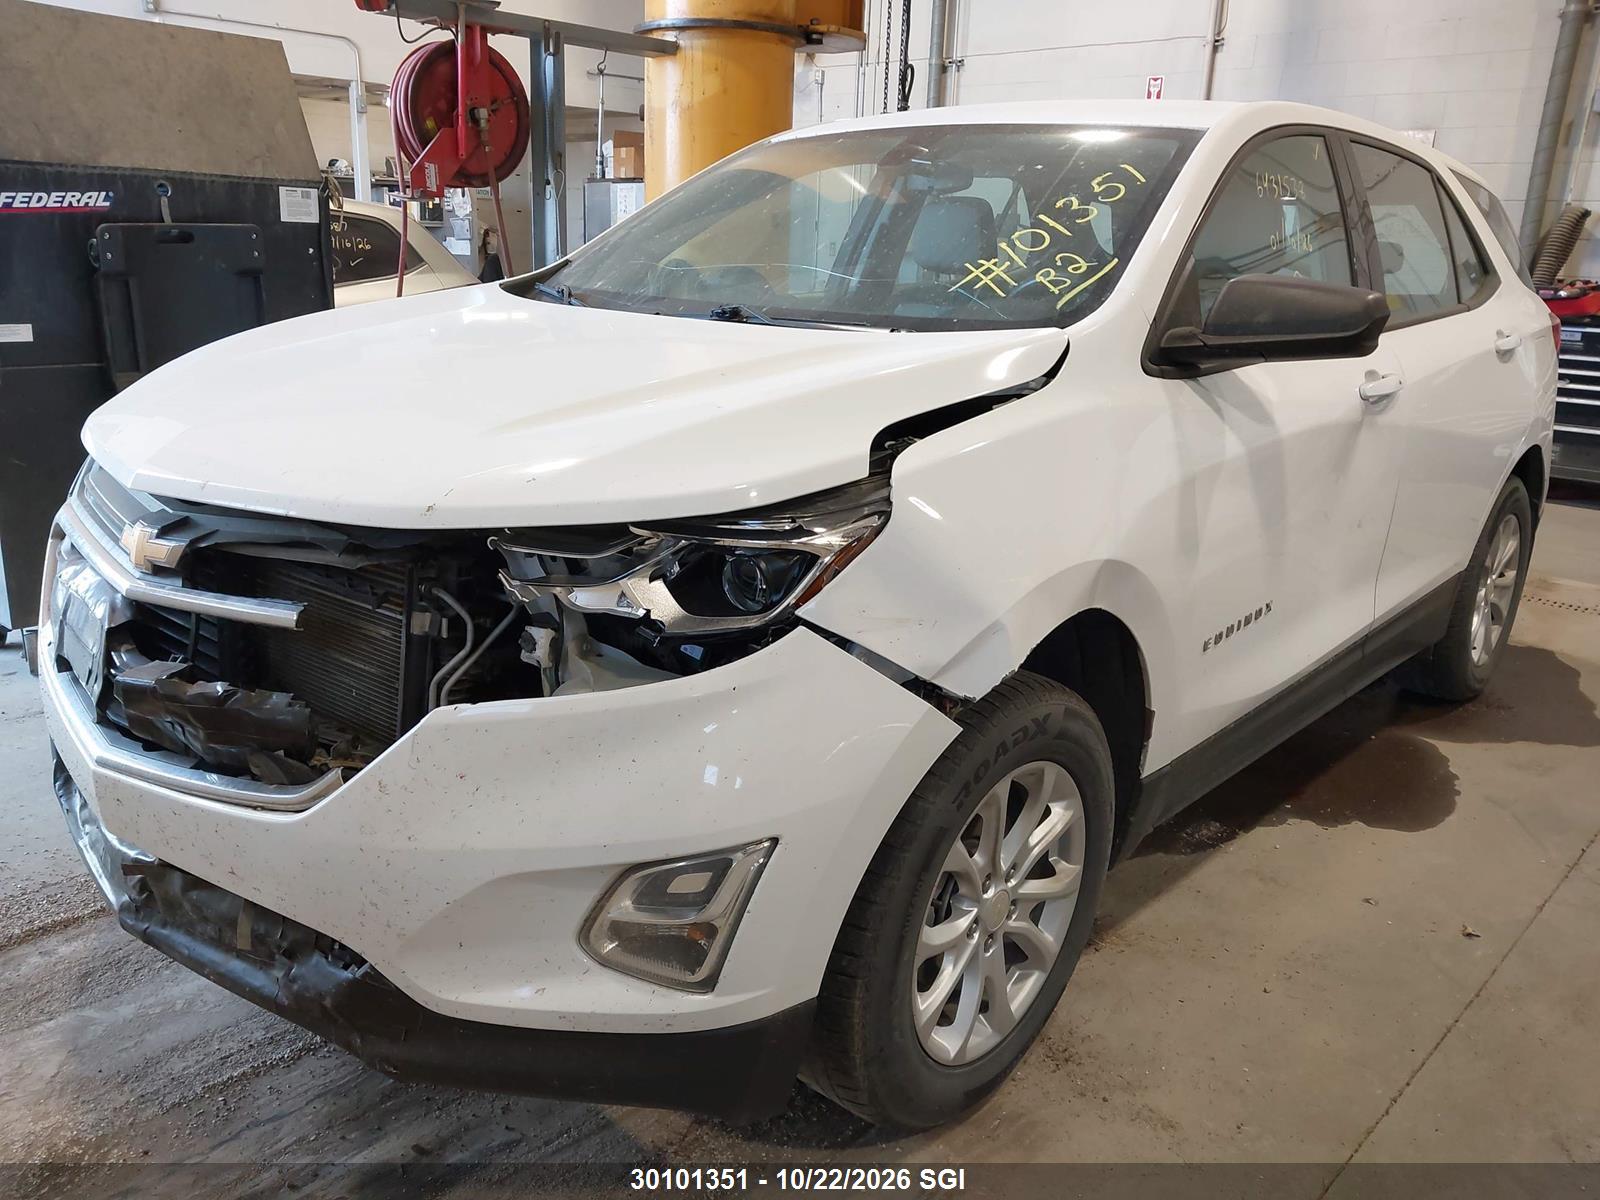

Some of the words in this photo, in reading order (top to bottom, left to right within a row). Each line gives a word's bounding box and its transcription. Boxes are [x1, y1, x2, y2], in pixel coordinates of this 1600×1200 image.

[0, 191, 110, 208] FEDERAL
[948, 163, 1147, 298] #101351
[1035, 253, 1099, 294] B2
[1203, 600, 1273, 653] EQUINOX
[951, 712, 1052, 812] ROADX
